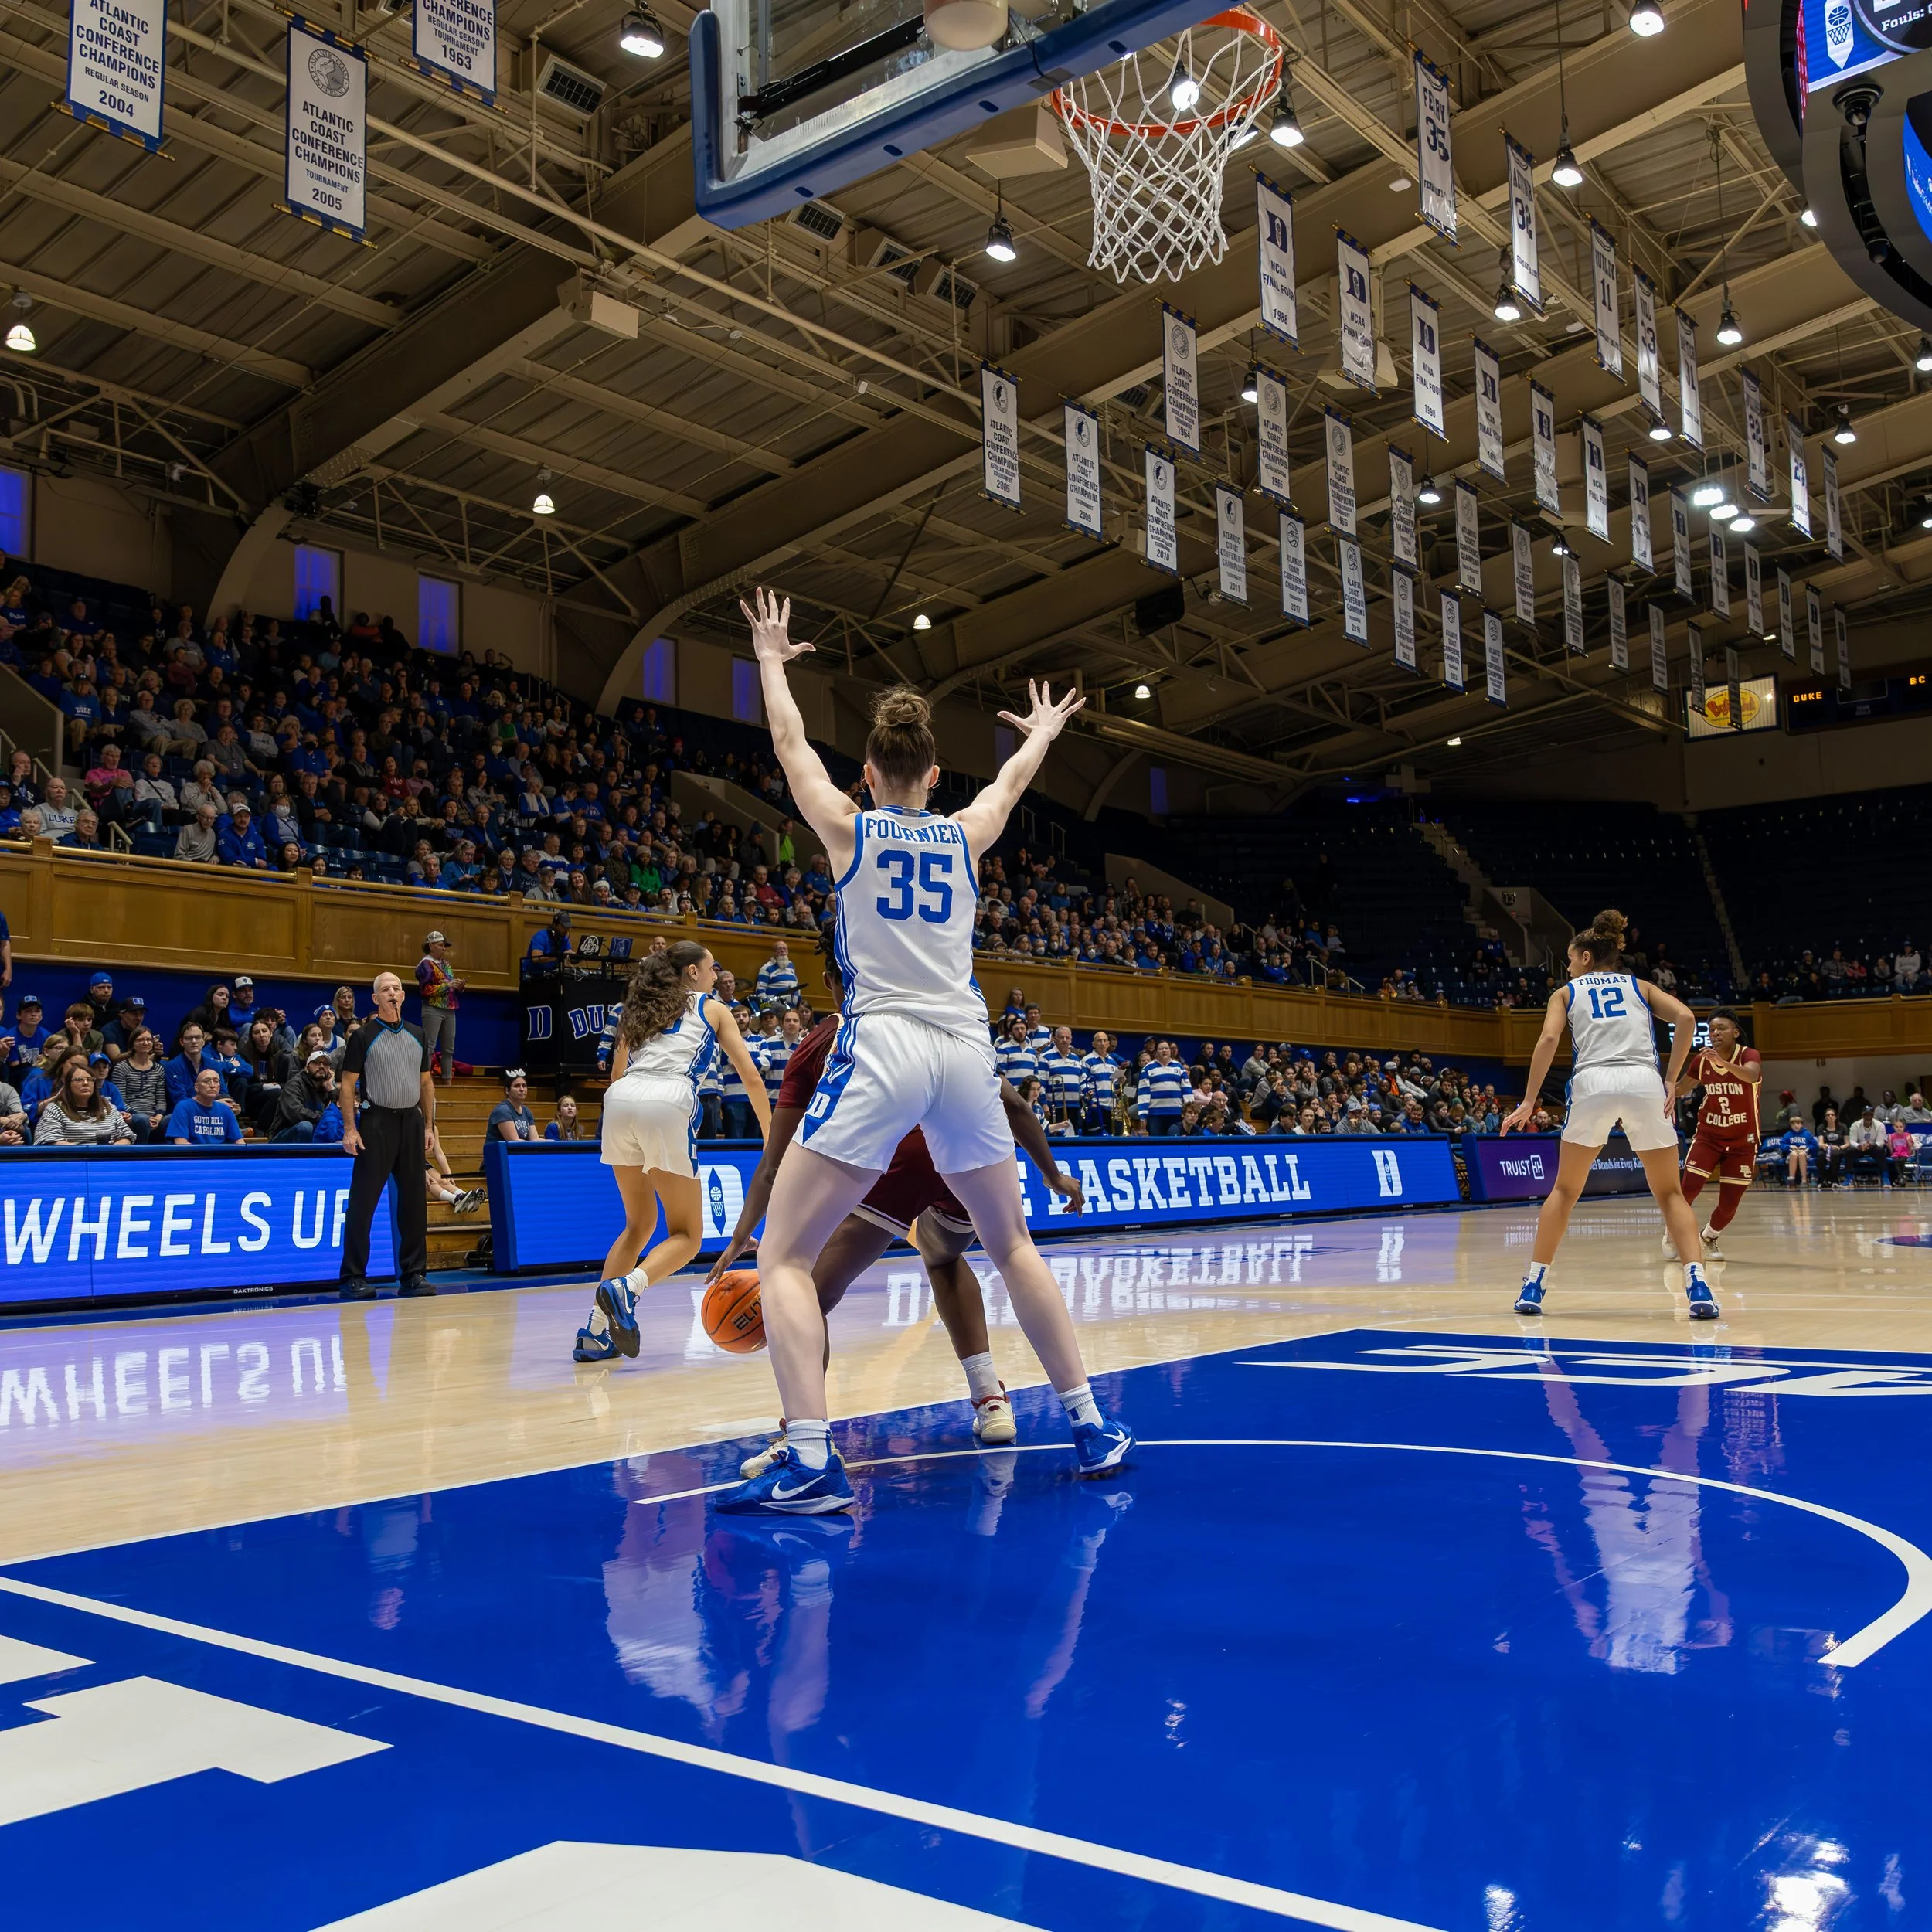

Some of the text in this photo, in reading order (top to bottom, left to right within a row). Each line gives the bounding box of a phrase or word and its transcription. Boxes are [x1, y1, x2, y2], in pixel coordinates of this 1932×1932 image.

[90, 0, 148, 35] ATLANTIC
[423, 0, 490, 41] CHAMPIONS
[443, 0, 492, 26] ERENCE
[1881, 9, 1924, 32] Fouls:
[100, 17, 140, 46] COAST
[427, 14, 485, 49] REGULAR SEASON
[434, 28, 478, 56] TOURNAMENT
[76, 24, 159, 74] CONFERENCE
[441, 44, 472, 70] 1963
[79, 43, 155, 89] CHAMPIONS
[85, 66, 149, 103] REGULAR SEASON
[99, 90, 134, 117] 2004
[302, 100, 354, 133] ATLANTIC
[310, 121, 345, 145] COAST
[1425, 116, 1450, 162] 35
[292, 128, 364, 169] CONFERENCE
[295, 145, 360, 184] CHAMPIONS
[306, 168, 349, 193] TOURNAMENT
[311, 188, 342, 211] 2005
[1270, 260, 1287, 278] NCAA
[1263, 273, 1280, 292] FINAL
[1600, 277, 1613, 312] 11
[1273, 308, 1287, 325] 1988
[1351, 311, 1366, 328] NCAA
[1172, 362, 1192, 383] ATLANTIC
[1422, 362, 1434, 377] NCAA
[1174, 376, 1189, 392] COAST
[1416, 373, 1429, 391] FINAL
[1167, 383, 1197, 408] CONFERENCE
[1169, 395, 1196, 419] CHAMPIONS
[1424, 404, 1436, 419] 1990
[990, 419, 1012, 437] ATLANTIC
[1177, 425, 1191, 440] 1964
[986, 440, 1019, 461] CONFERENCE
[993, 432, 1010, 447] COAST
[988, 451, 1018, 472] CHAMPIONS
[1072, 453, 1094, 469] ATLANTIC
[1077, 464, 1091, 478] COAST
[1069, 472, 1099, 493] CONFERENCE
[1070, 484, 1098, 503] CHAMPIONS
[1910, 675, 1926, 685] BC
[1793, 692, 1822, 702] DUKE
[865, 818, 962, 844] FOURNIER
[876, 849, 953, 924] 35
[1577, 975, 1628, 987] THOMAS
[1588, 987, 1627, 1019] 12
[527, 1005, 553, 1041] D
[568, 1004, 615, 1040] DU
[1704, 1083, 1743, 1097] BOSTON
[1718, 1097, 1730, 1114] 2
[193, 1115, 224, 1125] GO TO HELL
[194, 1124, 225, 1136] CAROLINA
[1706, 1113, 1747, 1127] COLLEGE
[1767, 1138, 1781, 1147] DUK
[1500, 1160, 1531, 1176] TRUIST
[1597, 1158, 1614, 1170] Brands
[1620, 1158, 1633, 1171] Every
[1633, 1158, 1644, 1168] Kin
[1048, 1154, 1311, 1216] BASKETBALL
[4, 1192, 272, 1265] WHEELS
[233, 1286, 274, 1294] DAKTRONICS
[733, 1298, 761, 1331] ELIT
